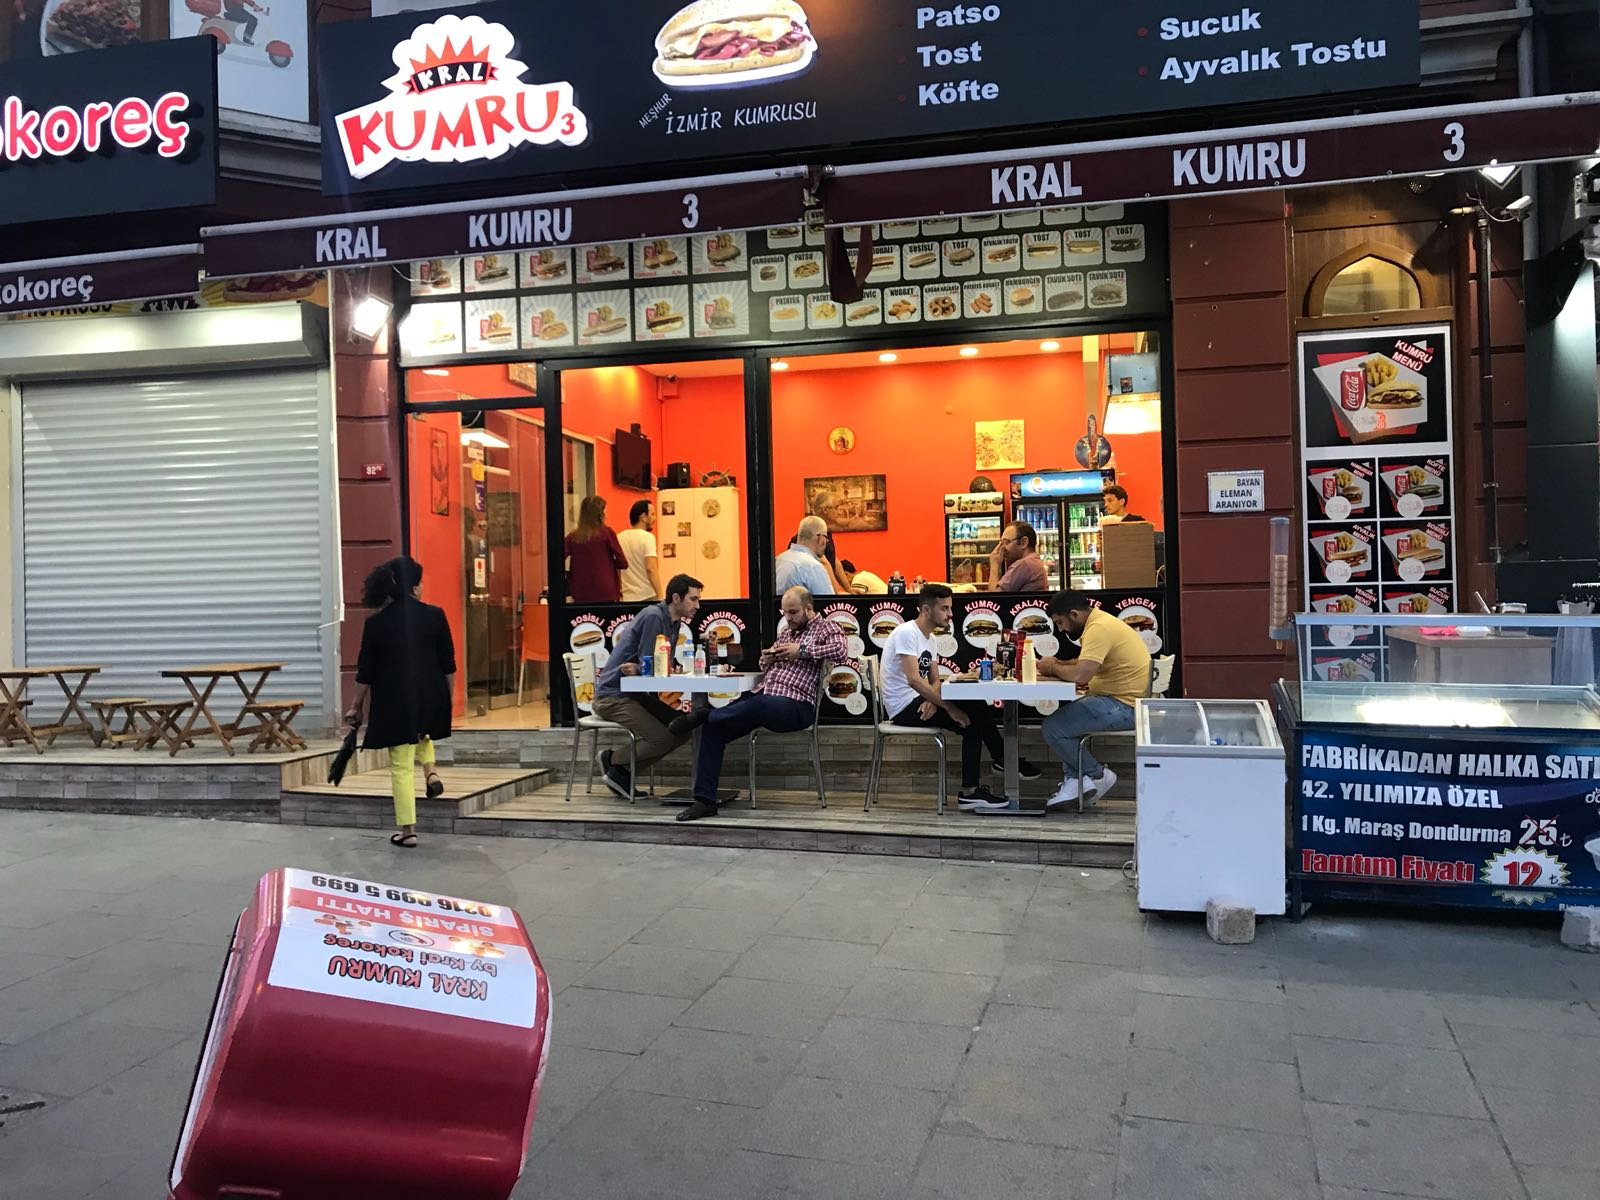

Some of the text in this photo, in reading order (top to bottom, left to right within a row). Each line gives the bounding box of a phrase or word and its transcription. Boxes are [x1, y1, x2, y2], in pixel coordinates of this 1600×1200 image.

[916, 3, 1000, 30] Patso
[1159, 8, 1262, 41] Sucuk
[916, 41, 982, 68] Tost
[1159, 36, 1386, 84] Ayvalık Tostu
[415, 62, 485, 90] KRAL
[918, 79, 999, 106] Köfte
[638, 93, 673, 129] MEŞHUR
[665, 101, 817, 135] İZMİR KUMRUSU
[0, 91, 190, 161] koreç
[343, 90, 576, 167] KUMRU 3
[991, 122, 1465, 204] KRAL KUMRU 3
[315, 193, 699, 263] KRAL KUMRU 3
[1033, 233, 1050, 243] TOST
[1074, 230, 1091, 239] TOST
[1116, 227, 1133, 236] TOST
[952, 240, 969, 250] TOST
[0, 274, 95, 302] okoreç
[890, 288, 914, 297] NUGGET
[1391, 351, 1423, 372] MENÜ
[1395, 340, 1433, 364] KUMRU
[1220, 489, 1253, 498] ELEMAN
[1236, 478, 1260, 487] BAYAN
[1215, 499, 1258, 509] ARANIYOR
[823, 602, 858, 615] KUMRU
[869, 602, 904, 614] KUMRU
[963, 599, 1001, 613] KUMRU
[1115, 597, 1157, 610] YENGEN
[570, 612, 605, 628] SOSİSLİ
[698, 611, 747, 632] HAMBURGER
[1302, 743, 1452, 775] FABRİKADAN
[1458, 752, 1540, 778] HALKA
[1302, 779, 1504, 809] 42. YILIMIZA ÖZEL
[1312, 814, 1341, 836] Kg.
[1344, 816, 1405, 841] Maraş
[1409, 821, 1512, 844] Dondurma
[1301, 849, 1475, 883] Tanıtım Fiyatı
[1503, 861, 1543, 887] 12
[311, 875, 359, 894] 699
[365, 885, 380, 898] 5
[316, 896, 495, 938] SİPARİŞ HATTI
[327, 955, 488, 1001] KRAL KUMRU
[472, 958, 497, 978] by
